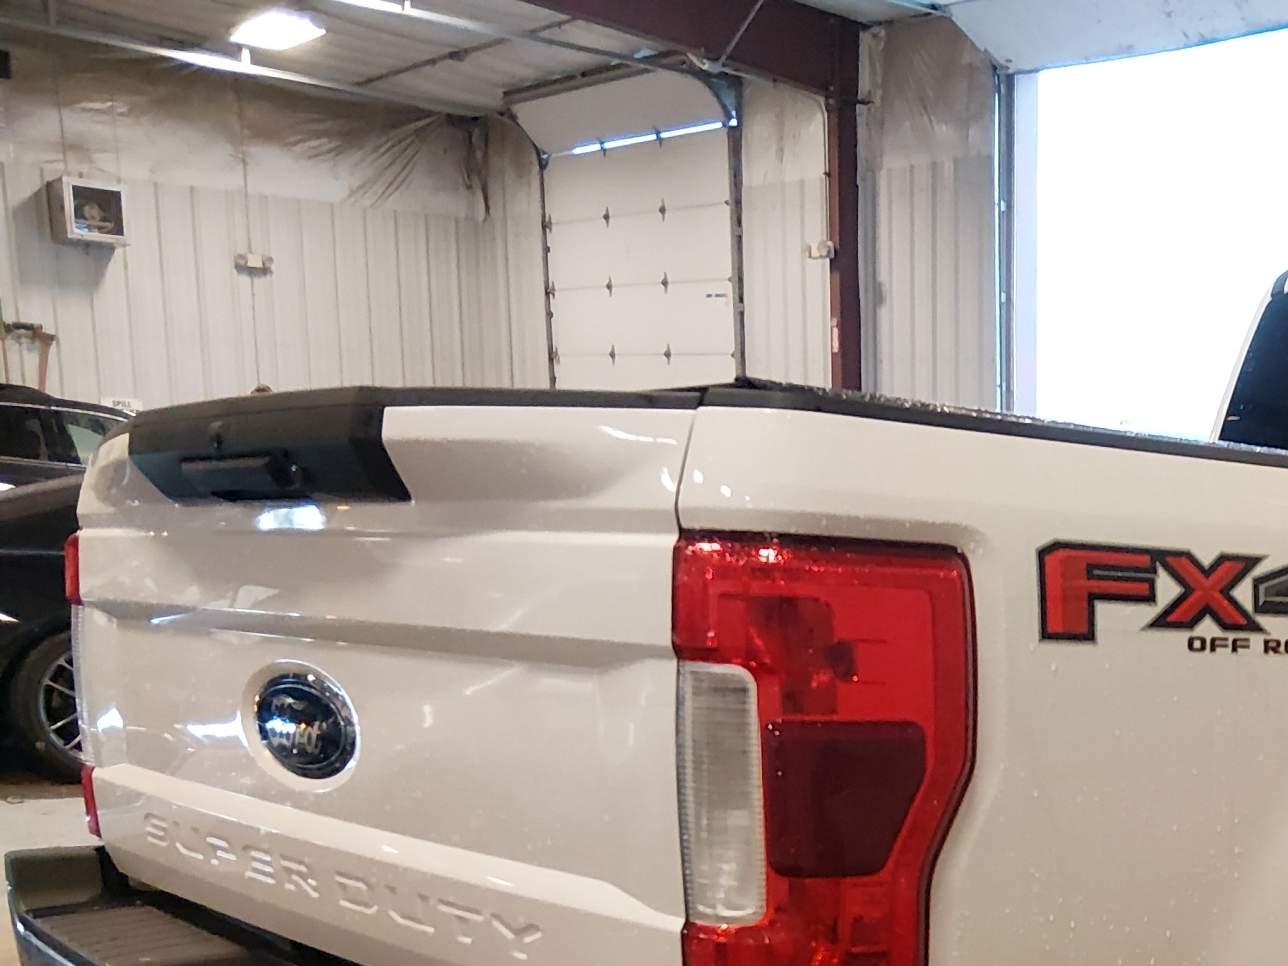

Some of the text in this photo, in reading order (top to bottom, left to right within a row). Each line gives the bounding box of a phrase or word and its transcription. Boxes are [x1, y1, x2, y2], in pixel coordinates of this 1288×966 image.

[1187, 635, 1250, 654] OFF
[143, 811, 542, 960] SUPER DUTY
